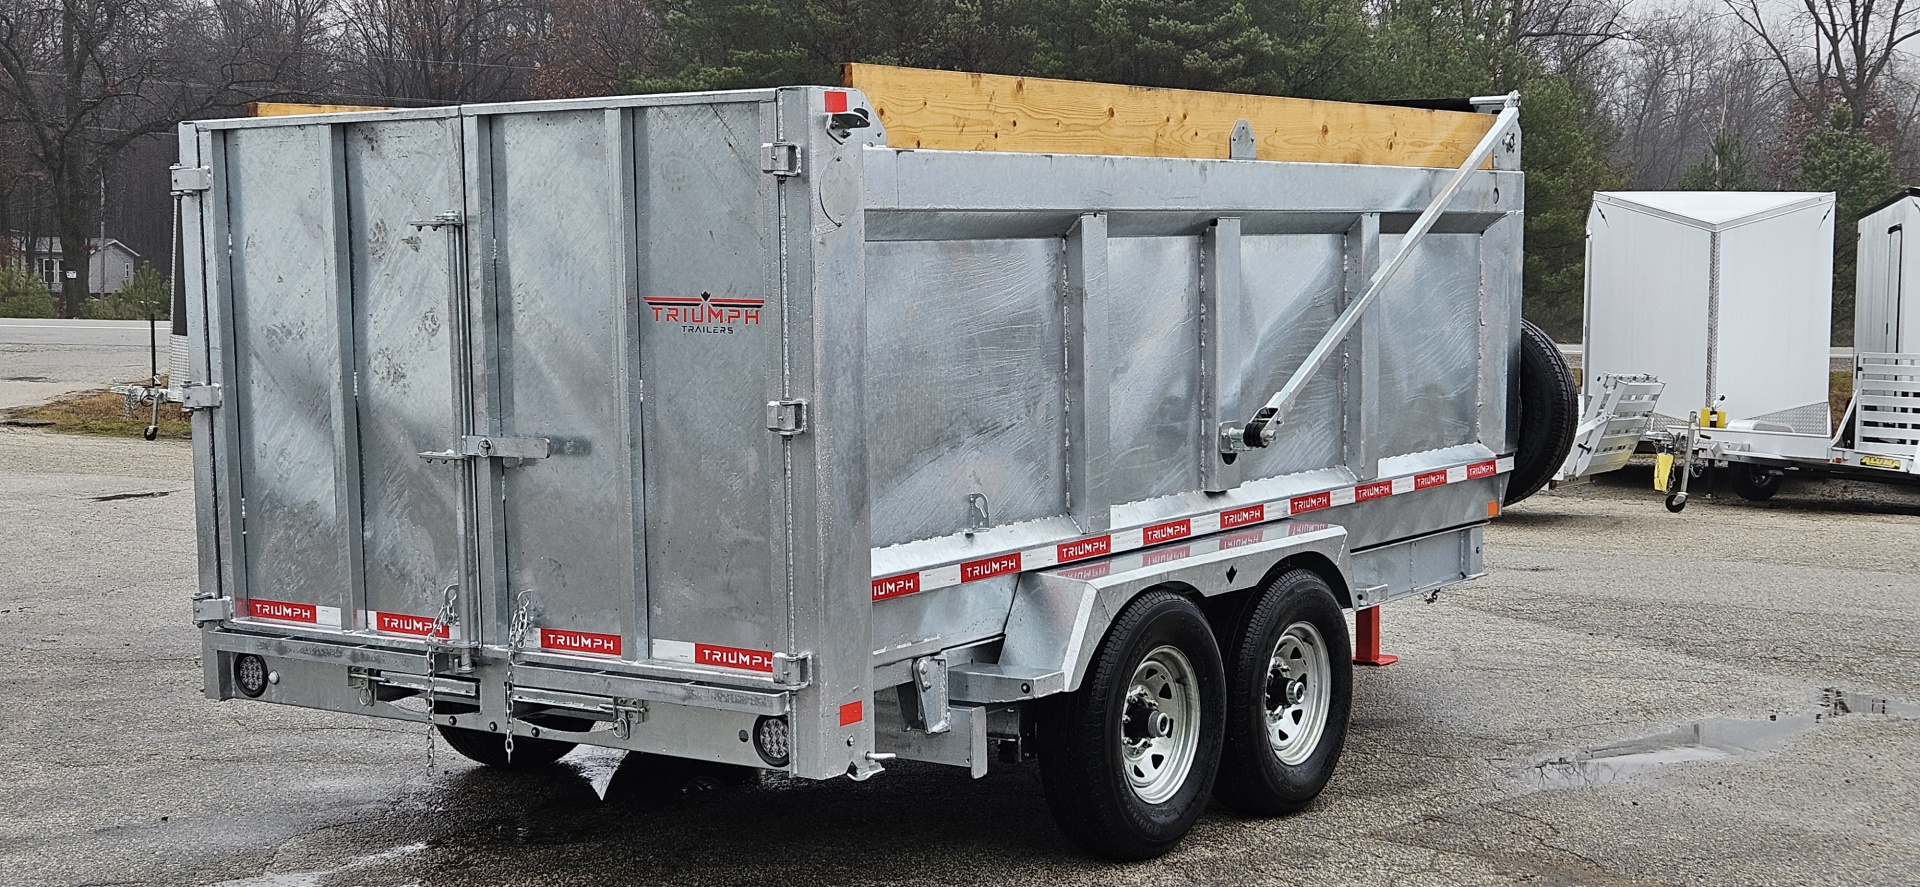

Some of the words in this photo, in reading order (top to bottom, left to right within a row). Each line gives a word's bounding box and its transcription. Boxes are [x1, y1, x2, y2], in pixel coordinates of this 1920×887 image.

[651, 304, 760, 325] TRIUMPH
[682, 325, 734, 334] TRAILERS
[1469, 464, 1494, 476] TRIUMPH
[1860, 456, 1901, 469] ALUMA
[1416, 474, 1445, 487] TRIUMPH
[1358, 485, 1390, 499] TRIUMPH
[1294, 496, 1327, 511] TRIUMPH
[1223, 509, 1261, 525] TRIUMPH
[1147, 523, 1187, 540] TRIUMPH
[1062, 541, 1107, 558] TRIUMPH
[966, 558, 1016, 578] TRIUMPH
[873, 579, 914, 596] IUMPH
[256, 604, 311, 619] TRIUMPH
[383, 617, 443, 634] TRIUMPH
[548, 634, 614, 650] TRIUMPH
[703, 650, 773, 668] TRIUMPH
